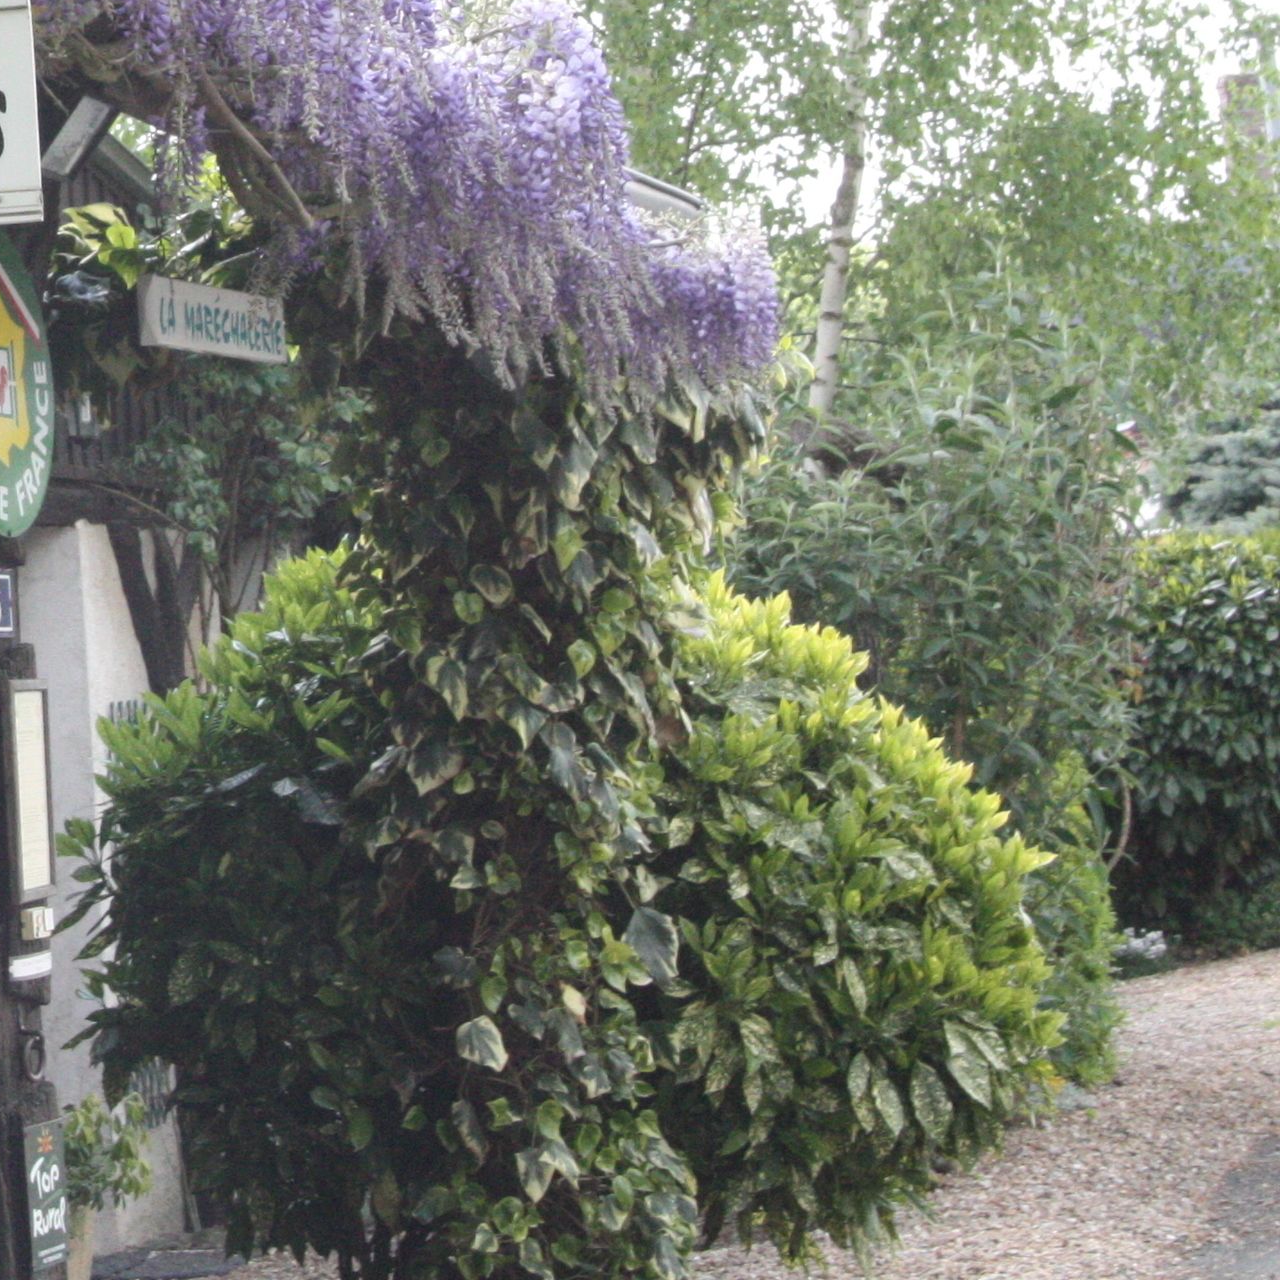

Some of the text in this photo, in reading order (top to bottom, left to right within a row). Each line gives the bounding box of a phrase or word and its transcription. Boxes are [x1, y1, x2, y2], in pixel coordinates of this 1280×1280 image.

[159, 293, 282, 355] LA MARÉCHALERIE
[15, 360, 49, 517] FRANCE
[32, 1196, 66, 1238] Rural
